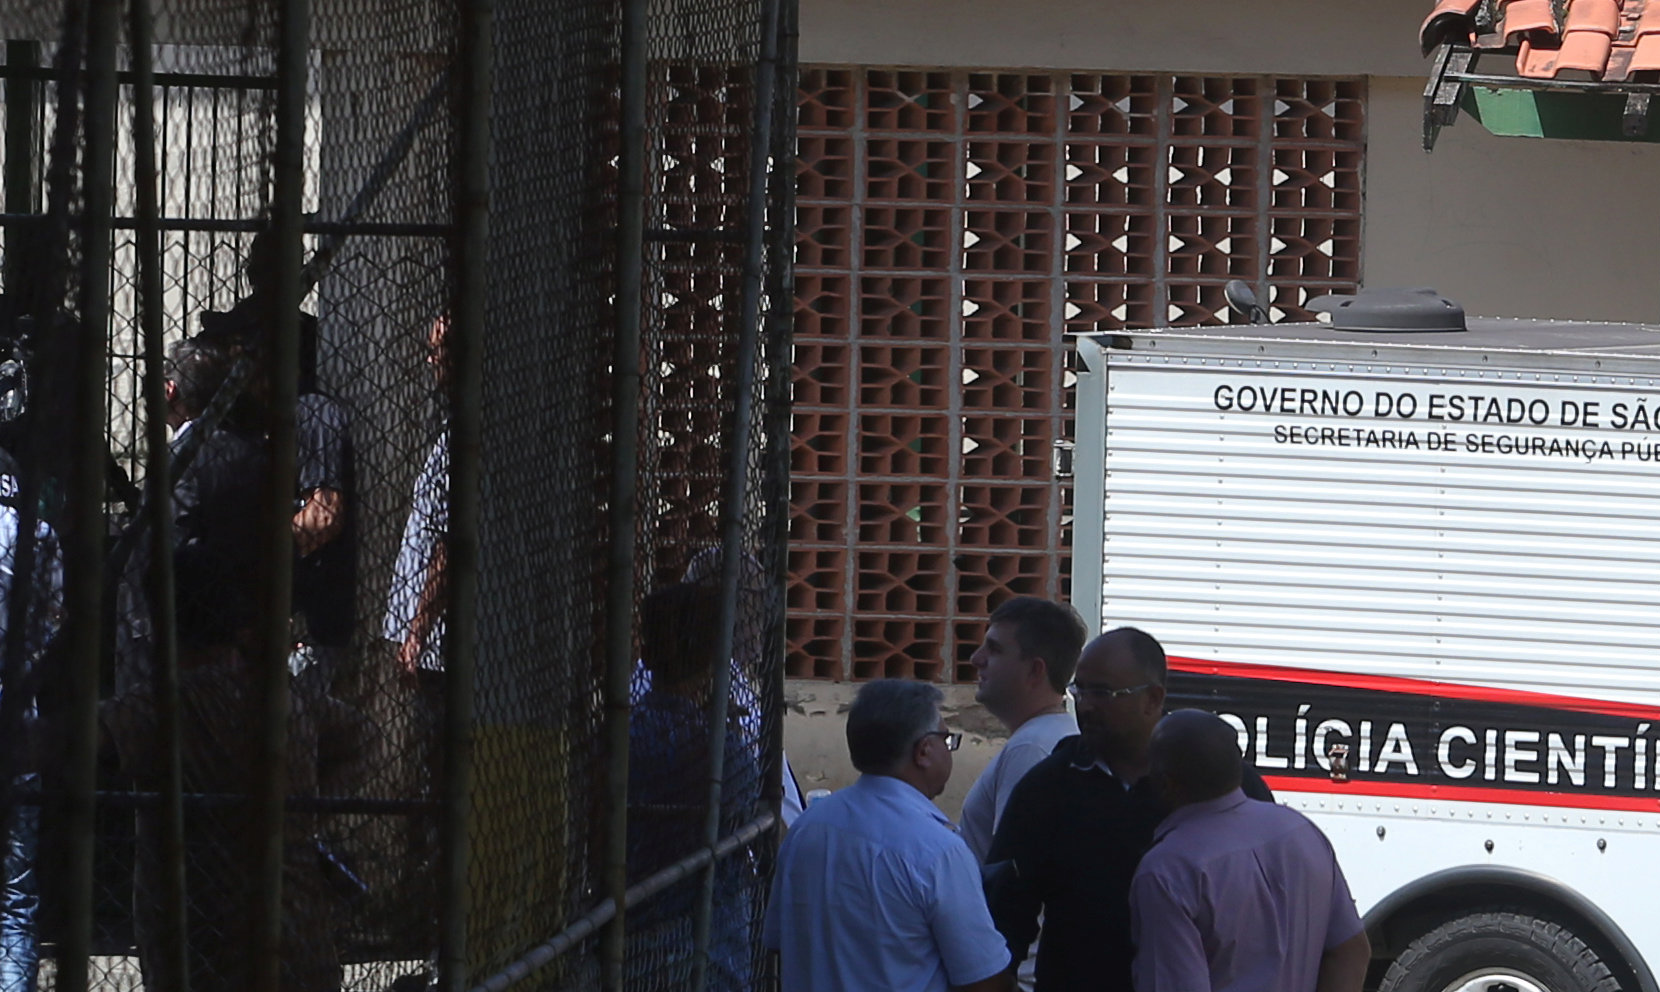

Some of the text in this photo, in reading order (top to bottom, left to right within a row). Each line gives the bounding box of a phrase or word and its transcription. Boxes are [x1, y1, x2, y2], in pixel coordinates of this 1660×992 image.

[1214, 384, 1364, 417] GOVERNO
[1374, 391, 1418, 419] DO
[1428, 394, 1550, 425] ESTADO
[1560, 400, 1600, 428] DE
[1274, 424, 1420, 450] SECRETARIA
[1427, 431, 1457, 452] DE
[1465, 433, 1614, 463] SEGURANÇA
[1216, 704, 1420, 776] LÍCIA
